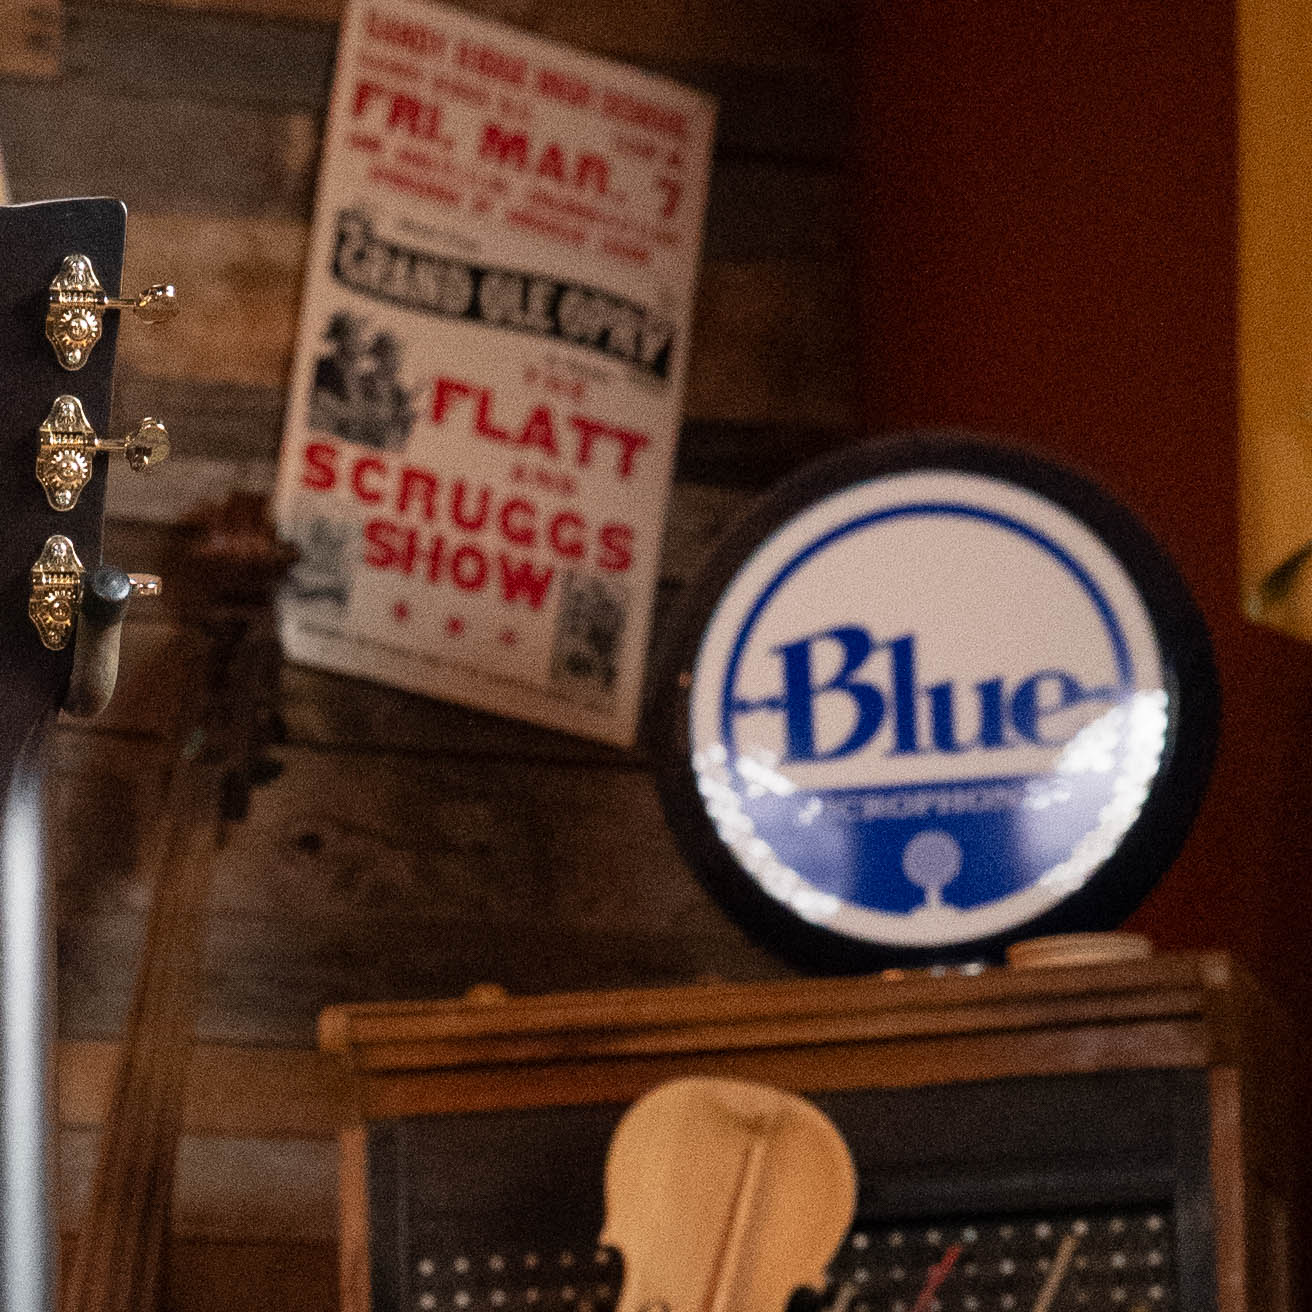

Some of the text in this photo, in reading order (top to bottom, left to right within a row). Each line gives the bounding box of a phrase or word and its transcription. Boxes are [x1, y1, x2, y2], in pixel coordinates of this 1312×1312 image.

[430, 374, 651, 480] FLATT
[300, 440, 637, 574] SCRUGGS
[363, 517, 556, 612] SHOW
[770, 624, 1082, 766] Blue
